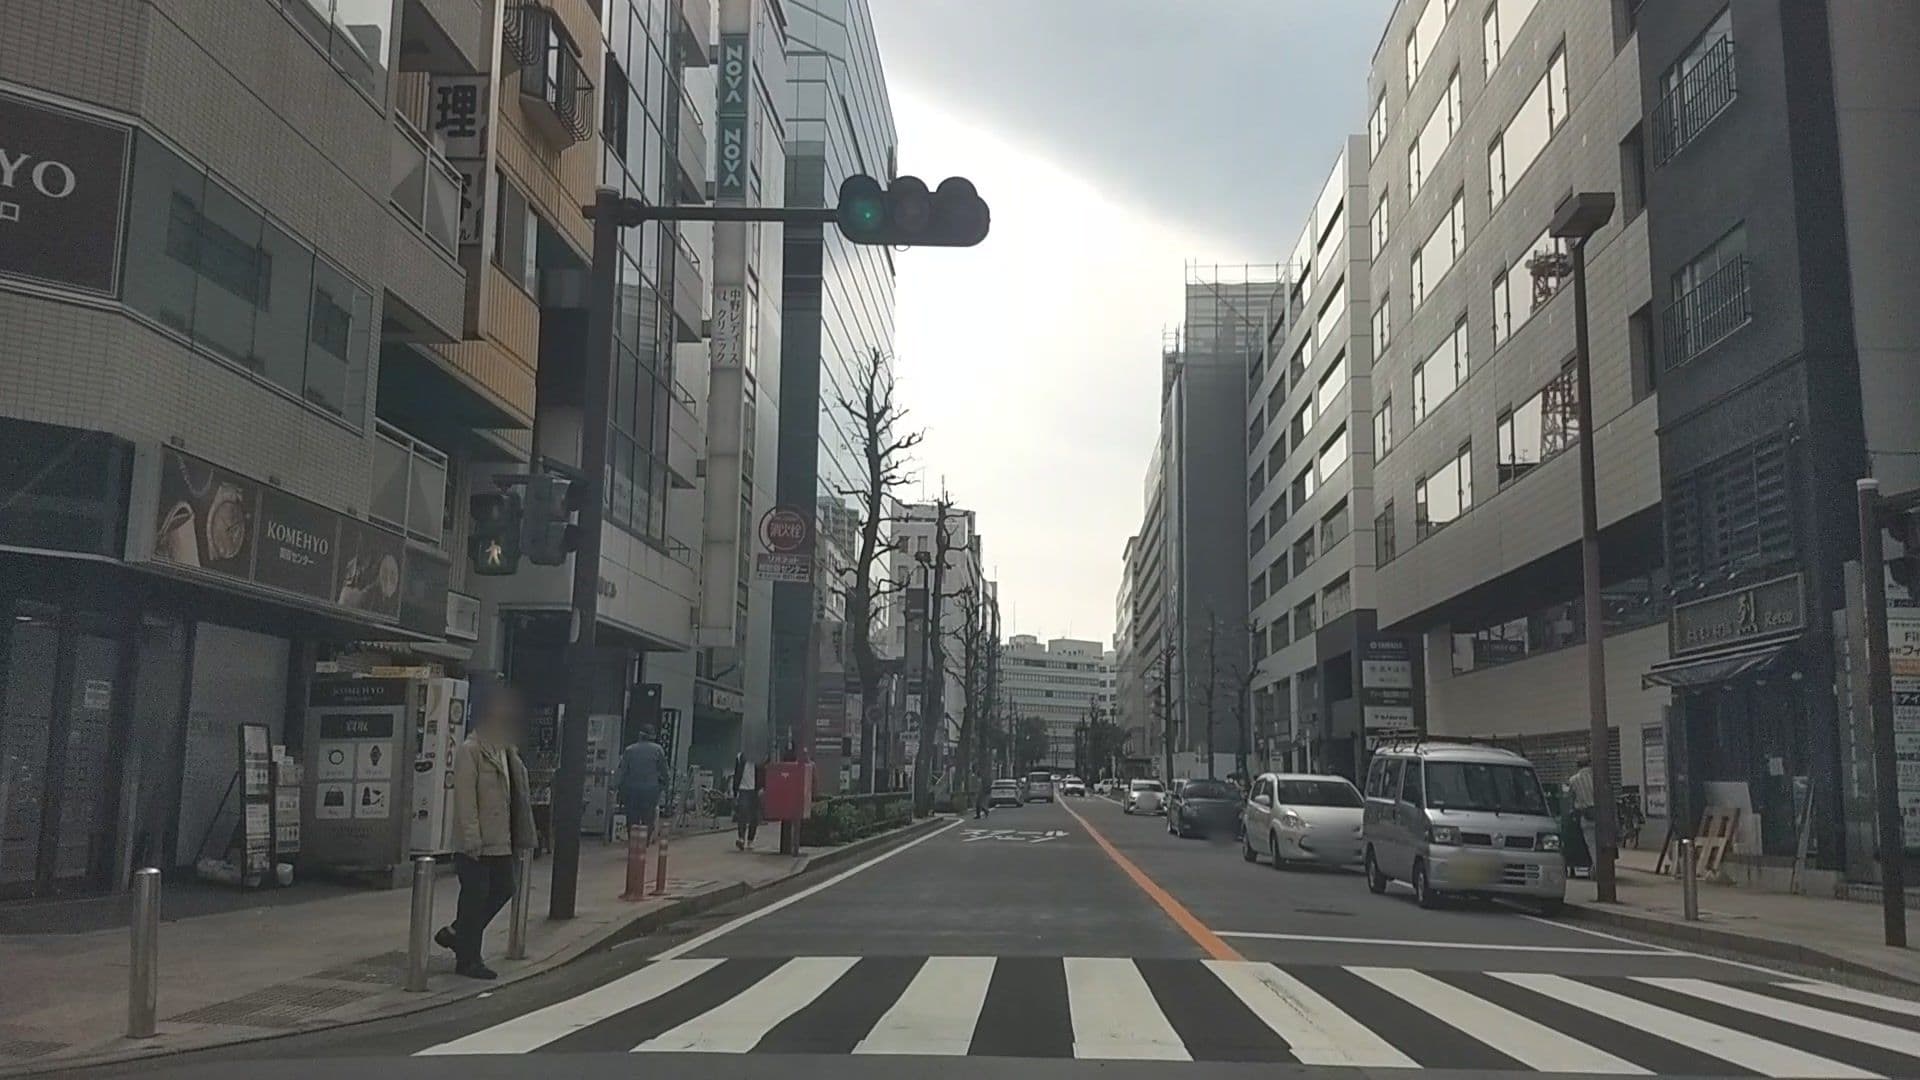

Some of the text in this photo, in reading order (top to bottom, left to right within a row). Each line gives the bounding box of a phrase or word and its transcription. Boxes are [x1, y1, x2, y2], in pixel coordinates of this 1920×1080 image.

[726, 45, 743, 102] NOVA
[724, 128, 741, 186] NOVA
[268, 520, 329, 555] KOMEHYO
